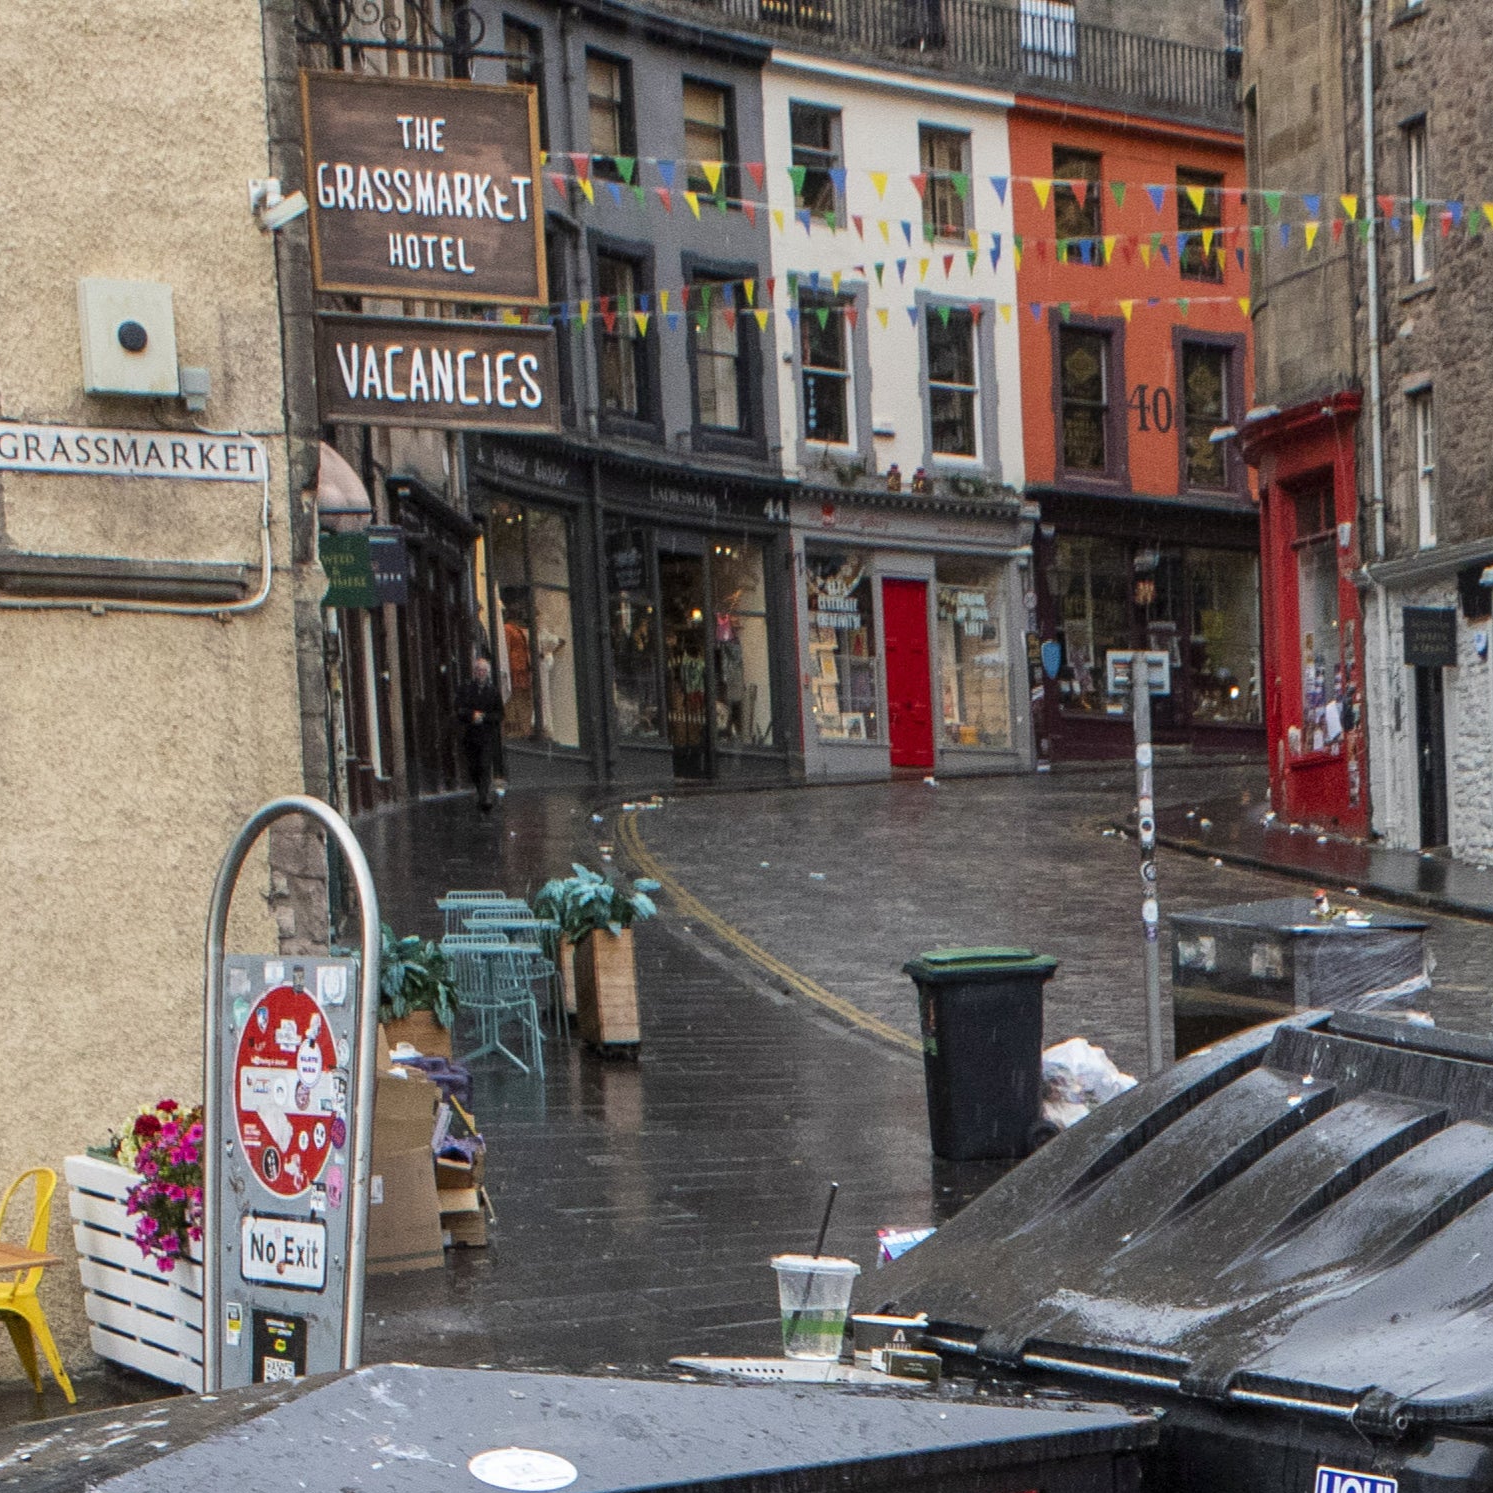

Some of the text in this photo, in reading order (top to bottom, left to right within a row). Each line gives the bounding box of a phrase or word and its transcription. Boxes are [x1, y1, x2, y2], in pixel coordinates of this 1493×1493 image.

[397, 115, 446, 153] THE
[315, 161, 532, 223] GRASSMARKET
[388, 231, 475, 275] HOTEL
[336, 342, 544, 408] VACANCIES
[1128, 384, 1174, 433] 40
[250, 1232, 319, 1270] No Exit
